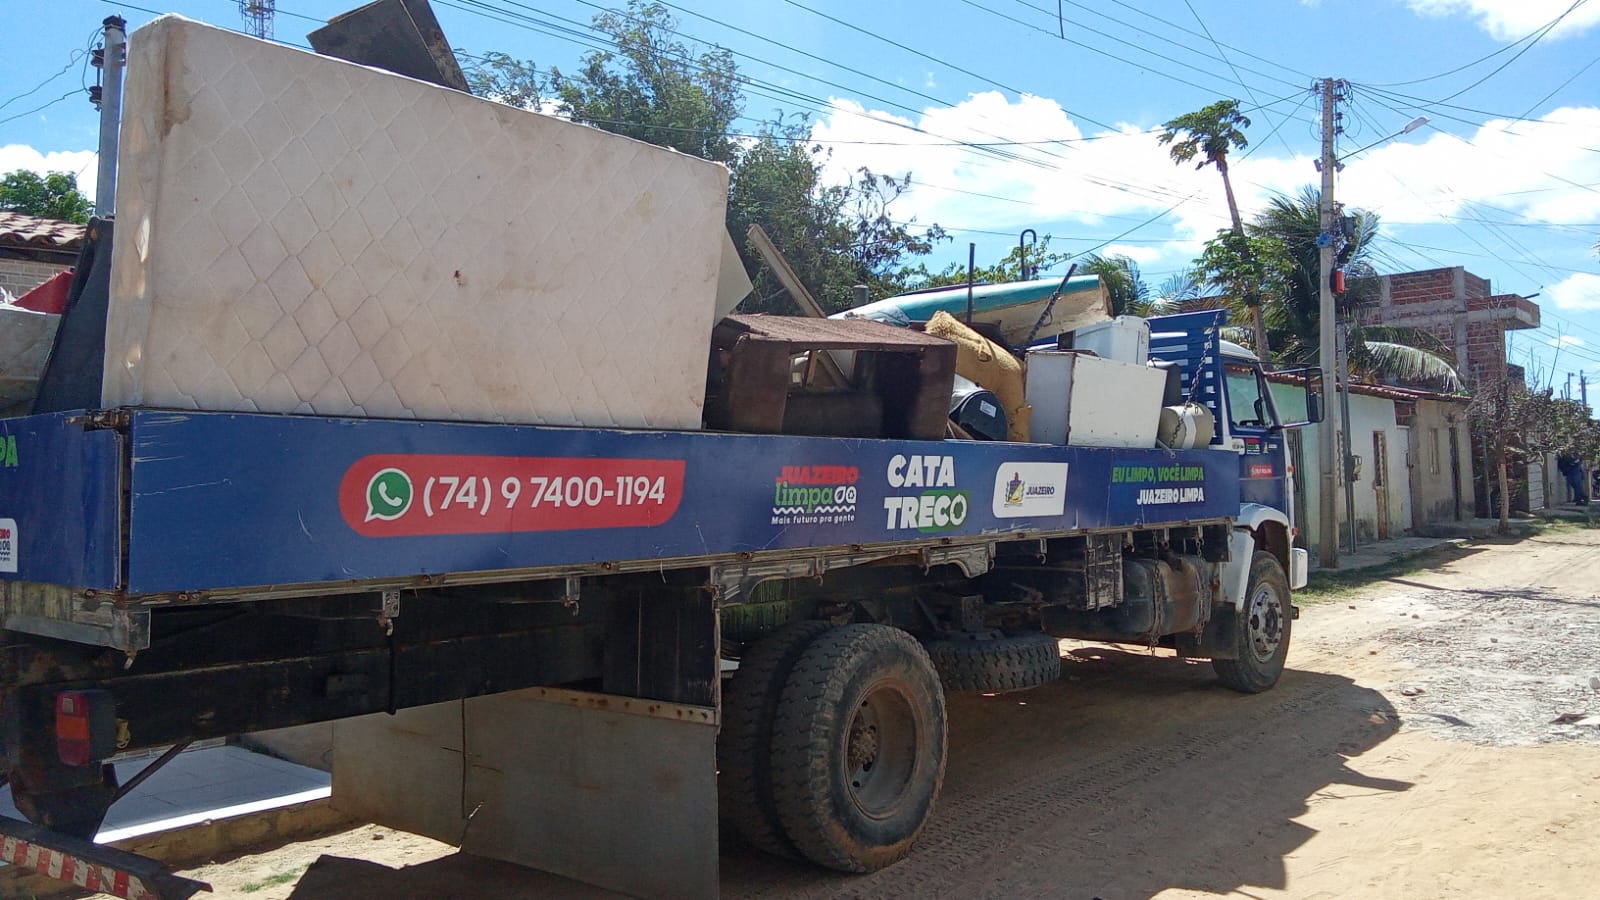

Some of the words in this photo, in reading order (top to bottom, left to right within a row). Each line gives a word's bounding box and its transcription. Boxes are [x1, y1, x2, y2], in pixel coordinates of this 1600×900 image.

[887, 454, 956, 488] CATA
[1112, 467, 1124, 483] EU
[1125, 467, 1156, 484] LIMPO,
[1158, 463, 1180, 482] VOCÊ
[1181, 466, 1204, 481] LIMPA
[423, 476, 492, 517] (74)
[501, 476, 521, 509] 9
[530, 475, 666, 509] 7400-1194
[775, 480, 833, 513] limpa
[1026, 486, 1055, 496] JUAZEIRO
[1136, 489, 1179, 505] JUAZEIRO
[1180, 487, 1204, 503] LIMPA
[771, 516, 791, 525] Mais
[793, 515, 818, 524] futuro
[819, 515, 833, 525] pra
[834, 514, 855, 524] gente
[883, 494, 967, 530] TRECO
